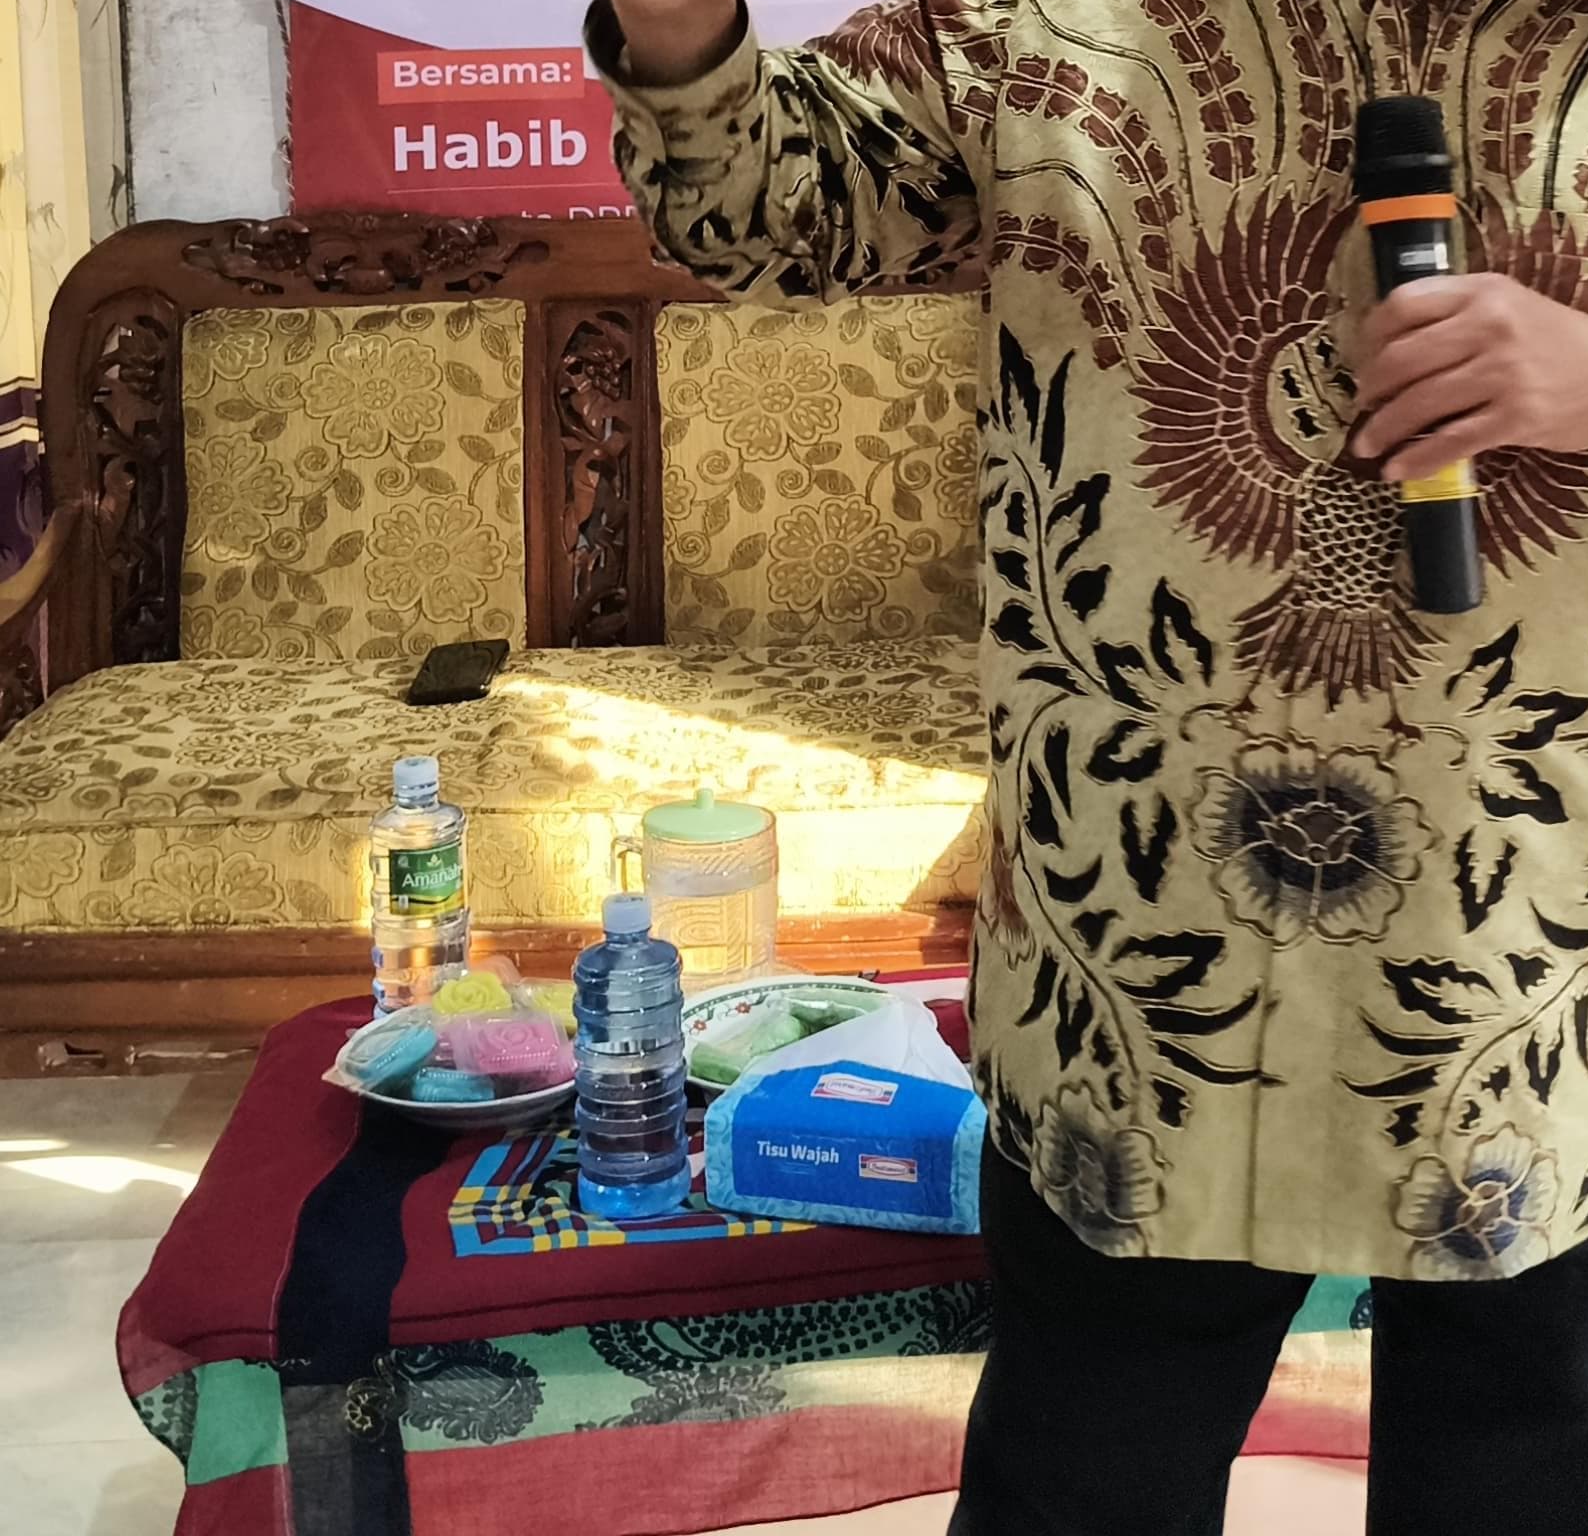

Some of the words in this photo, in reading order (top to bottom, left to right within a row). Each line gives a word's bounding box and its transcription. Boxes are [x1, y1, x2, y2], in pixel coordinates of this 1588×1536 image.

[393, 60, 572, 88] Bersama:
[394, 119, 587, 172] Habib
[756, 1140, 788, 1158] Tisu
[791, 1144, 840, 1166] Wajah
